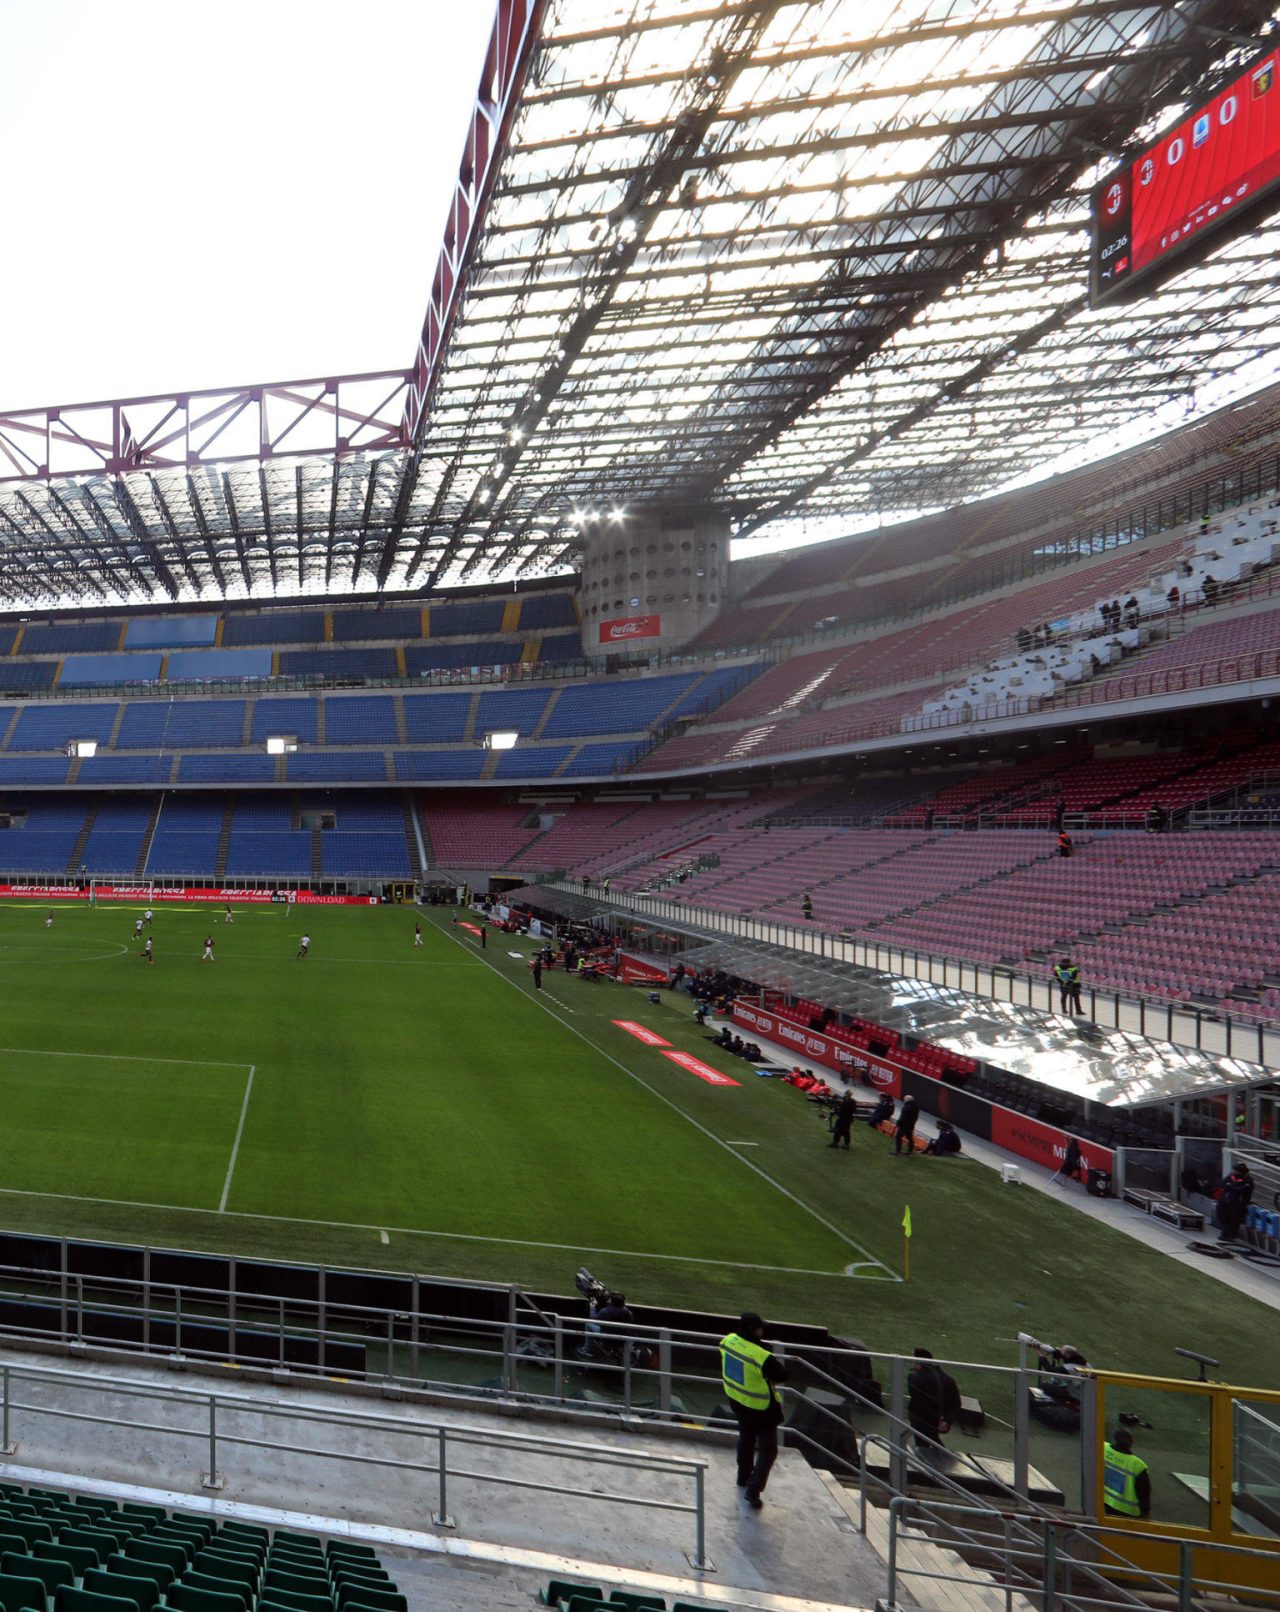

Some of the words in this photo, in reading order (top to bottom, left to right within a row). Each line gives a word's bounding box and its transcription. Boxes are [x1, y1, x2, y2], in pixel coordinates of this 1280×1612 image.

[1219, 95, 1237, 125] 0
[1167, 137, 1183, 165] 0
[1101, 234, 1128, 260] 02:26
[297, 895, 345, 904] DOWNLOAD
[733, 1003, 756, 1023] Emirates
[778, 1022, 806, 1045] Emirates
